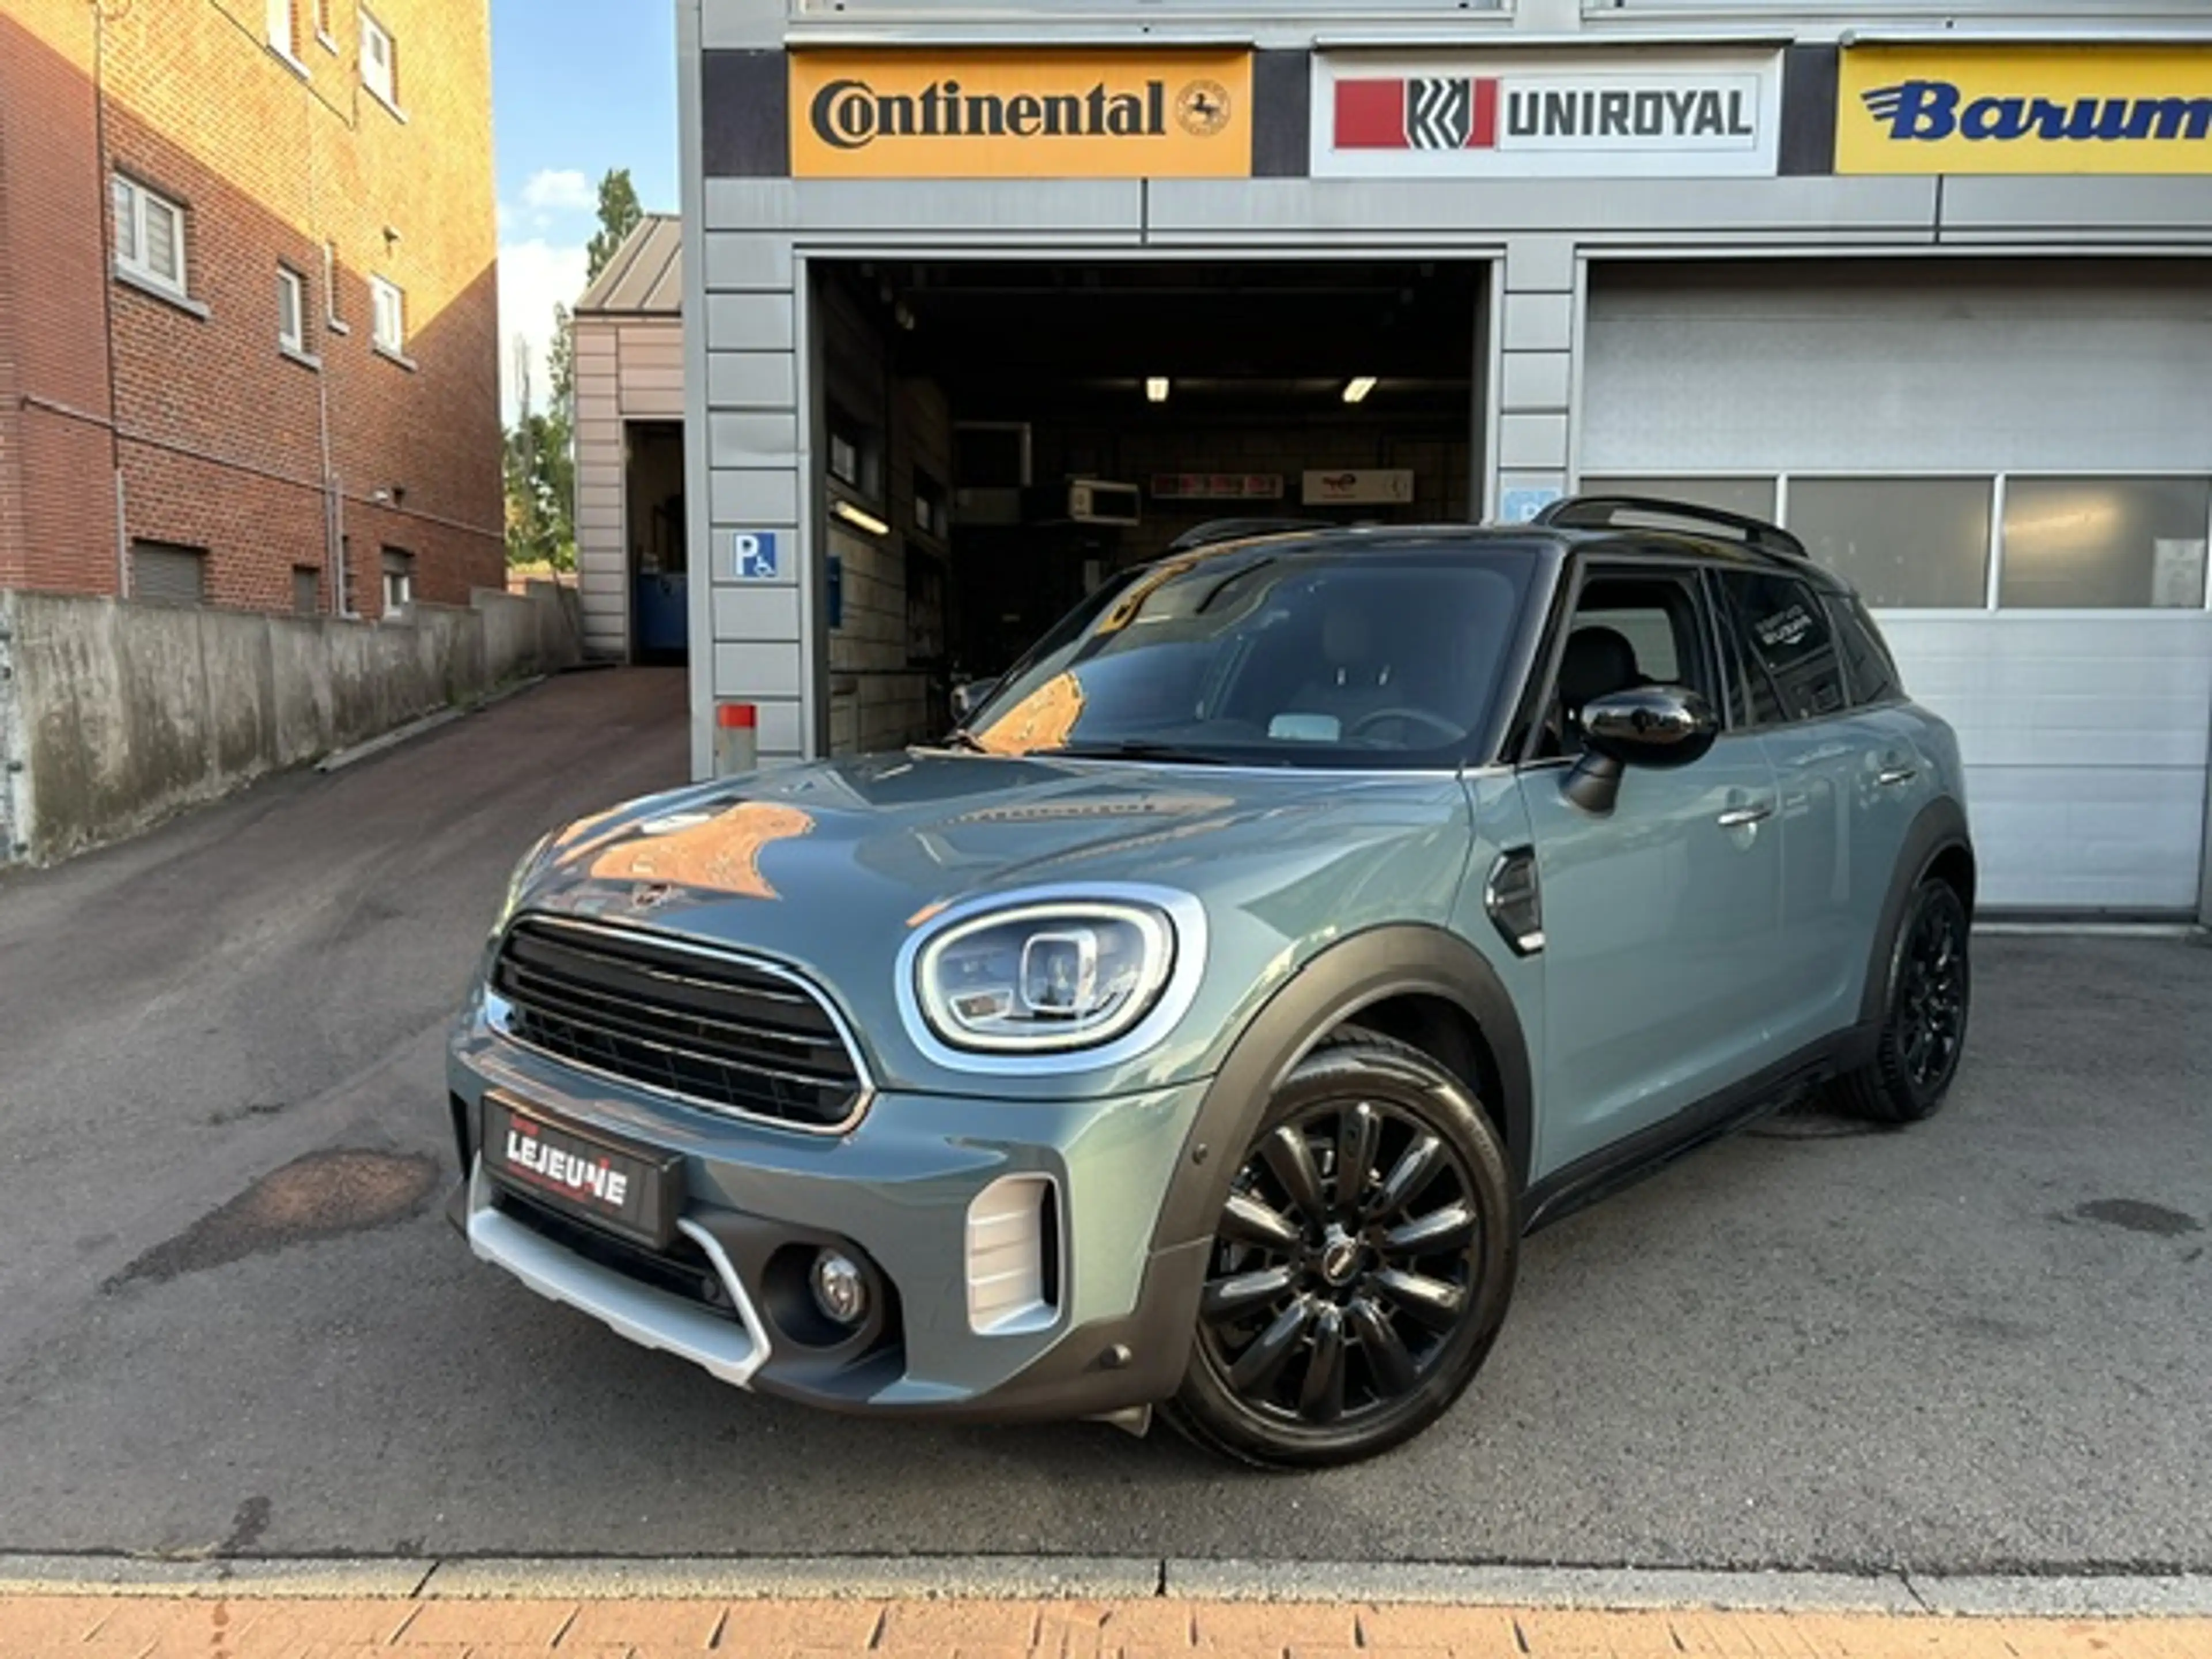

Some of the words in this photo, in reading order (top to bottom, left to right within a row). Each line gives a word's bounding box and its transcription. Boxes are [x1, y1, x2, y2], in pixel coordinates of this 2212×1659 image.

[810, 78, 1166, 150] Continental
[1508, 90, 1753, 136] UNIROYAL
[1861, 79, 2212, 141] Barum
[735, 535, 759, 575] P
[506, 1129, 628, 1206] LEJEUNE
